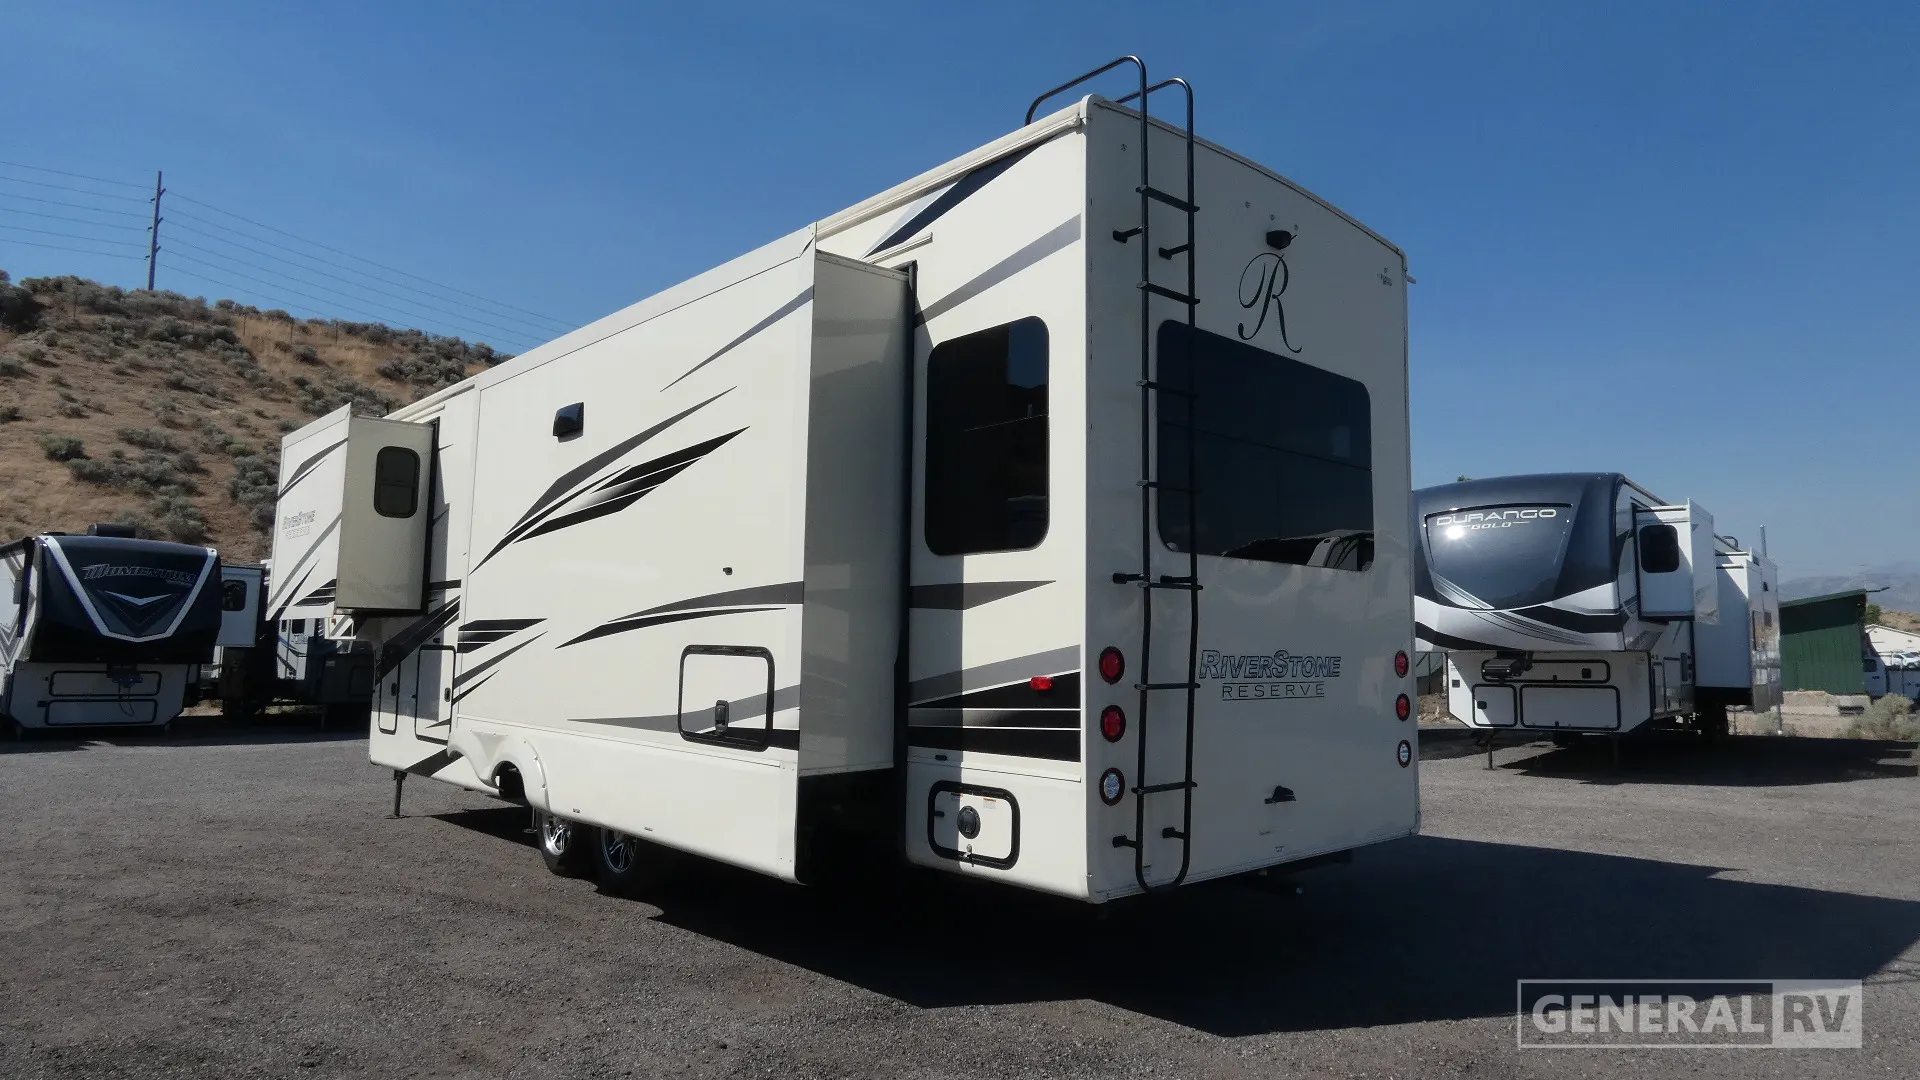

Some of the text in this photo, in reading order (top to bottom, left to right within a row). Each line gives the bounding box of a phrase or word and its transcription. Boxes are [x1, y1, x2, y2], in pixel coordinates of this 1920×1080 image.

[1238, 252, 1303, 354] R
[1436, 508, 1557, 526] DURANGO
[1470, 521, 1513, 530] GOLD
[1222, 683, 1325, 698] RESERVE
